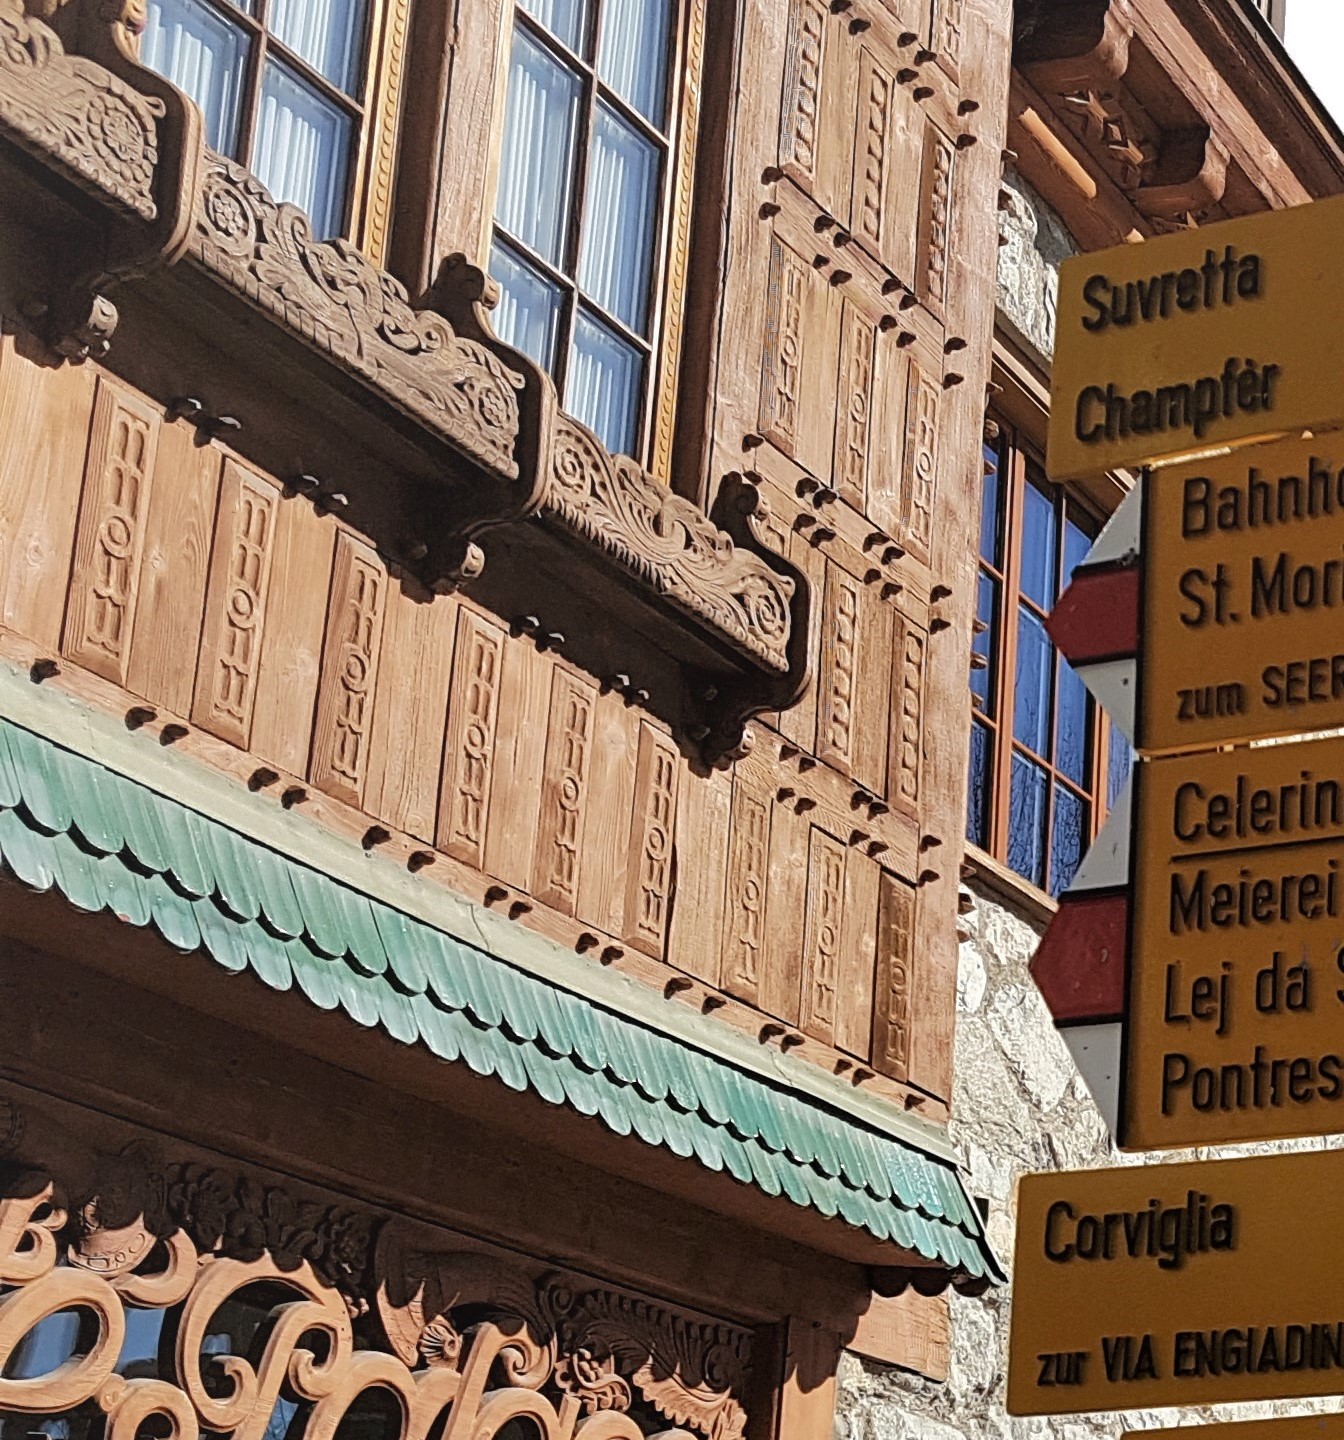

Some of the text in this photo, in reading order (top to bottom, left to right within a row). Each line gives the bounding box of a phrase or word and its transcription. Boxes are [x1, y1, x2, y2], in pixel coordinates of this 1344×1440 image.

[1081, 245, 1260, 332] Suvretta
[1177, 682, 1246, 720] zum
[1164, 960, 1232, 1035] Lej
[1255, 951, 1312, 1013] da
[1044, 1189, 1237, 1270] Corviglia
[1037, 1352, 1090, 1386] zur
[1101, 1334, 1161, 1382] VIA
